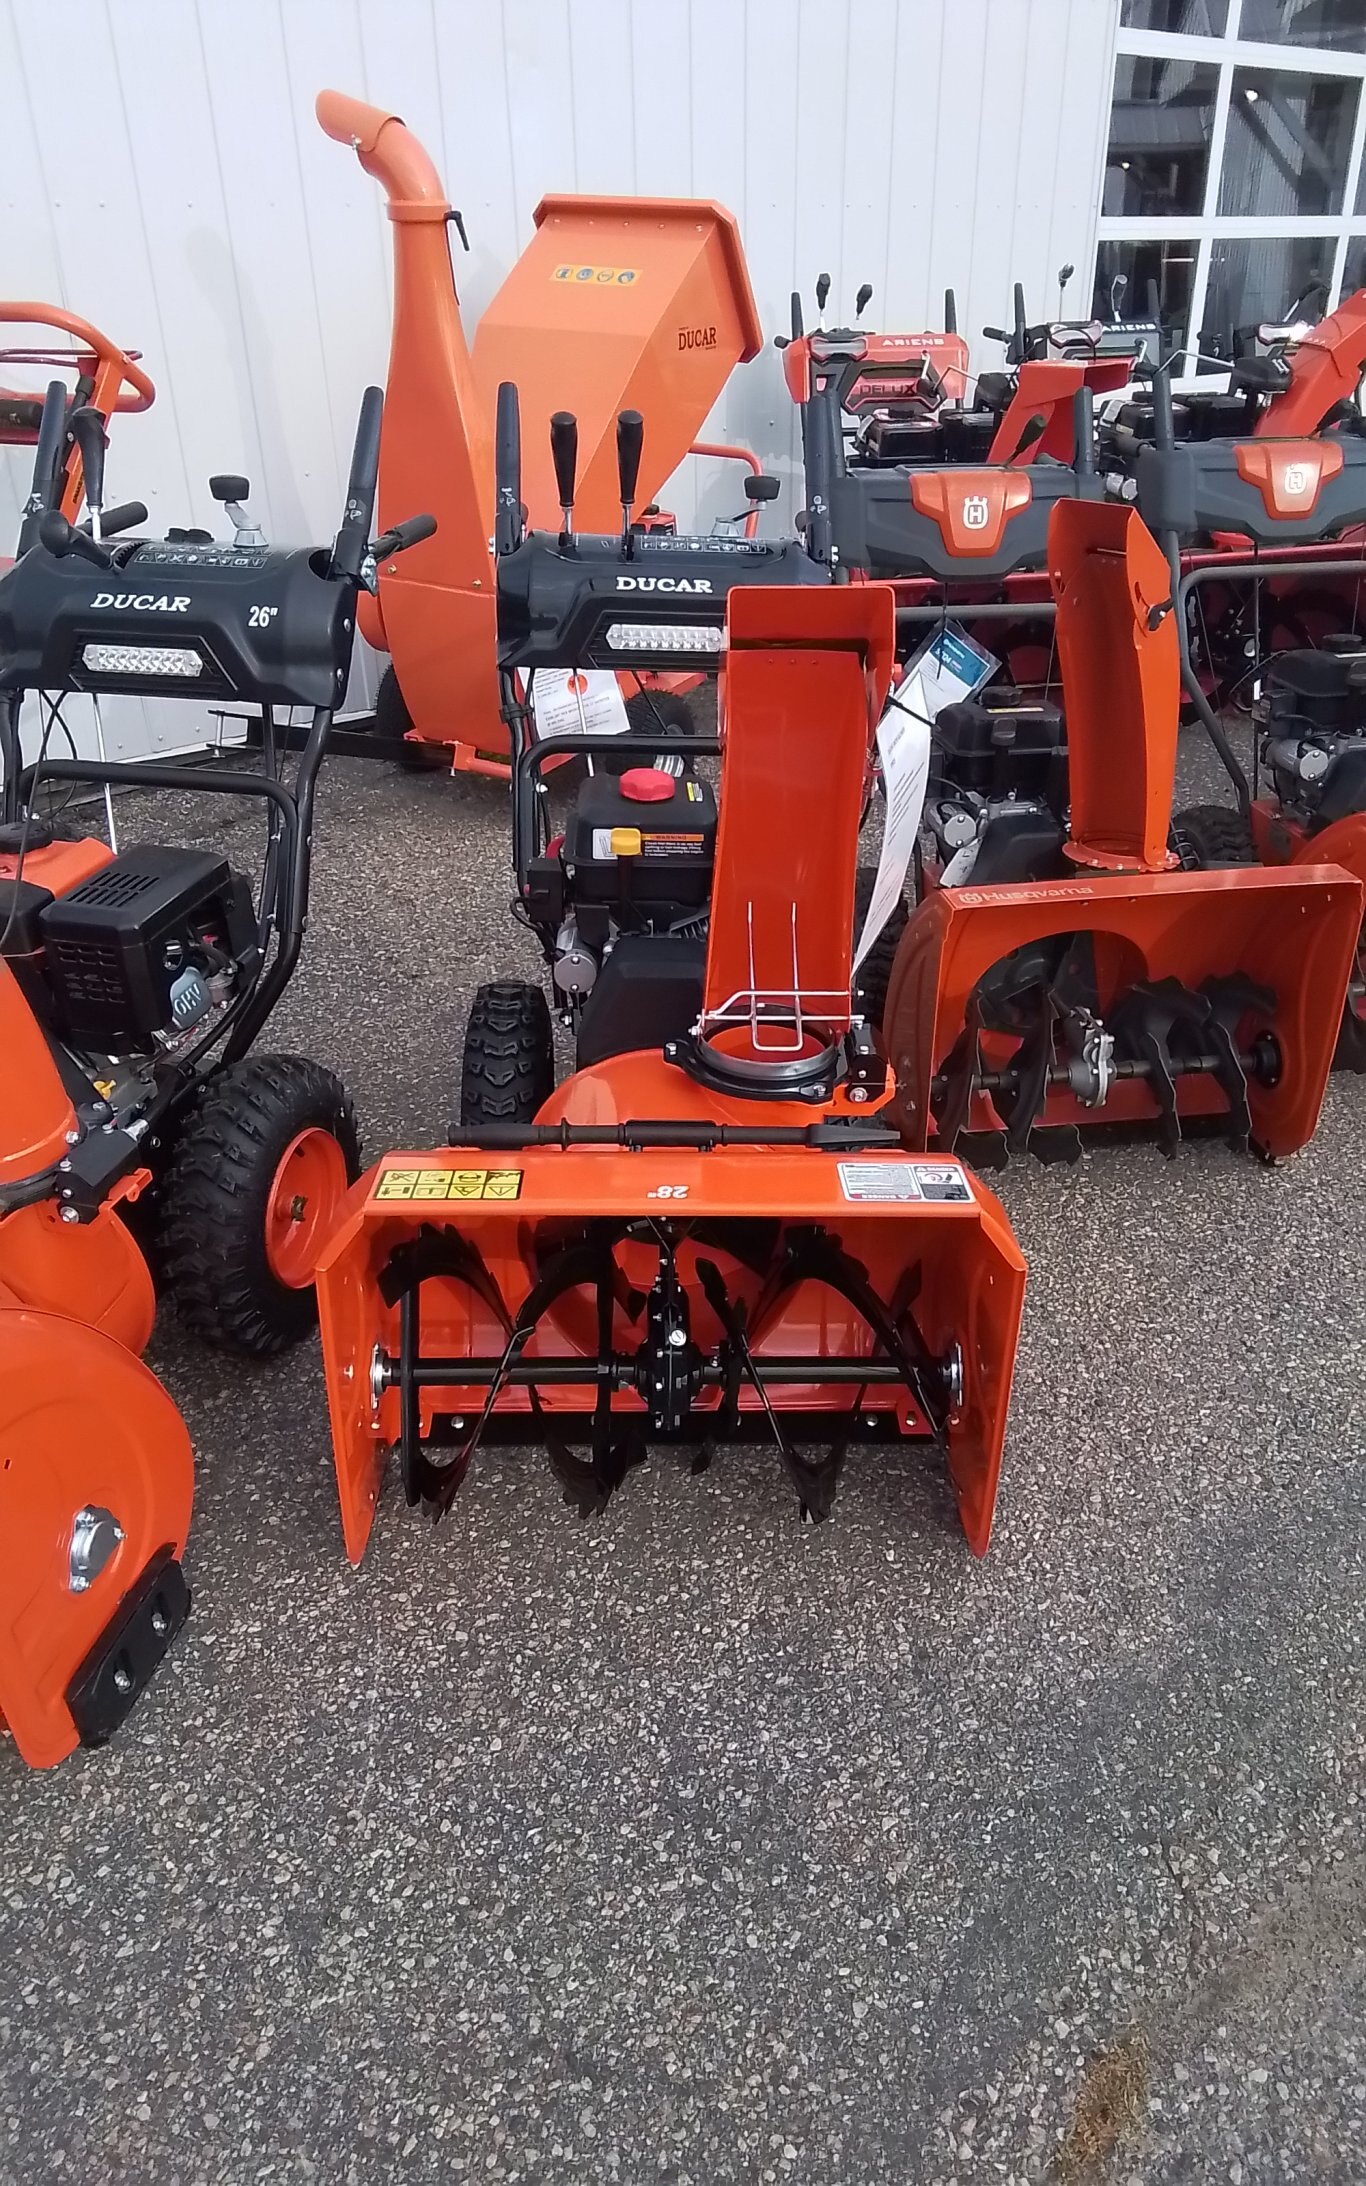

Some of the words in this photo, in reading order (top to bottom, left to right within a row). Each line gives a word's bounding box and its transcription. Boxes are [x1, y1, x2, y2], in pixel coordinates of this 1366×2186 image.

[1102, 323, 1157, 332] ARIENS
[678, 326, 717, 351] DUCAR
[882, 338, 945, 346] ARIENS
[860, 384, 916, 396] DELUX
[616, 576, 713, 594] DUCAR
[90, 593, 192, 613] DUCAR
[248, 606, 278, 628] 26"
[982, 887, 1094, 901] Husqvarna
[174, 983, 201, 1016] OHV
